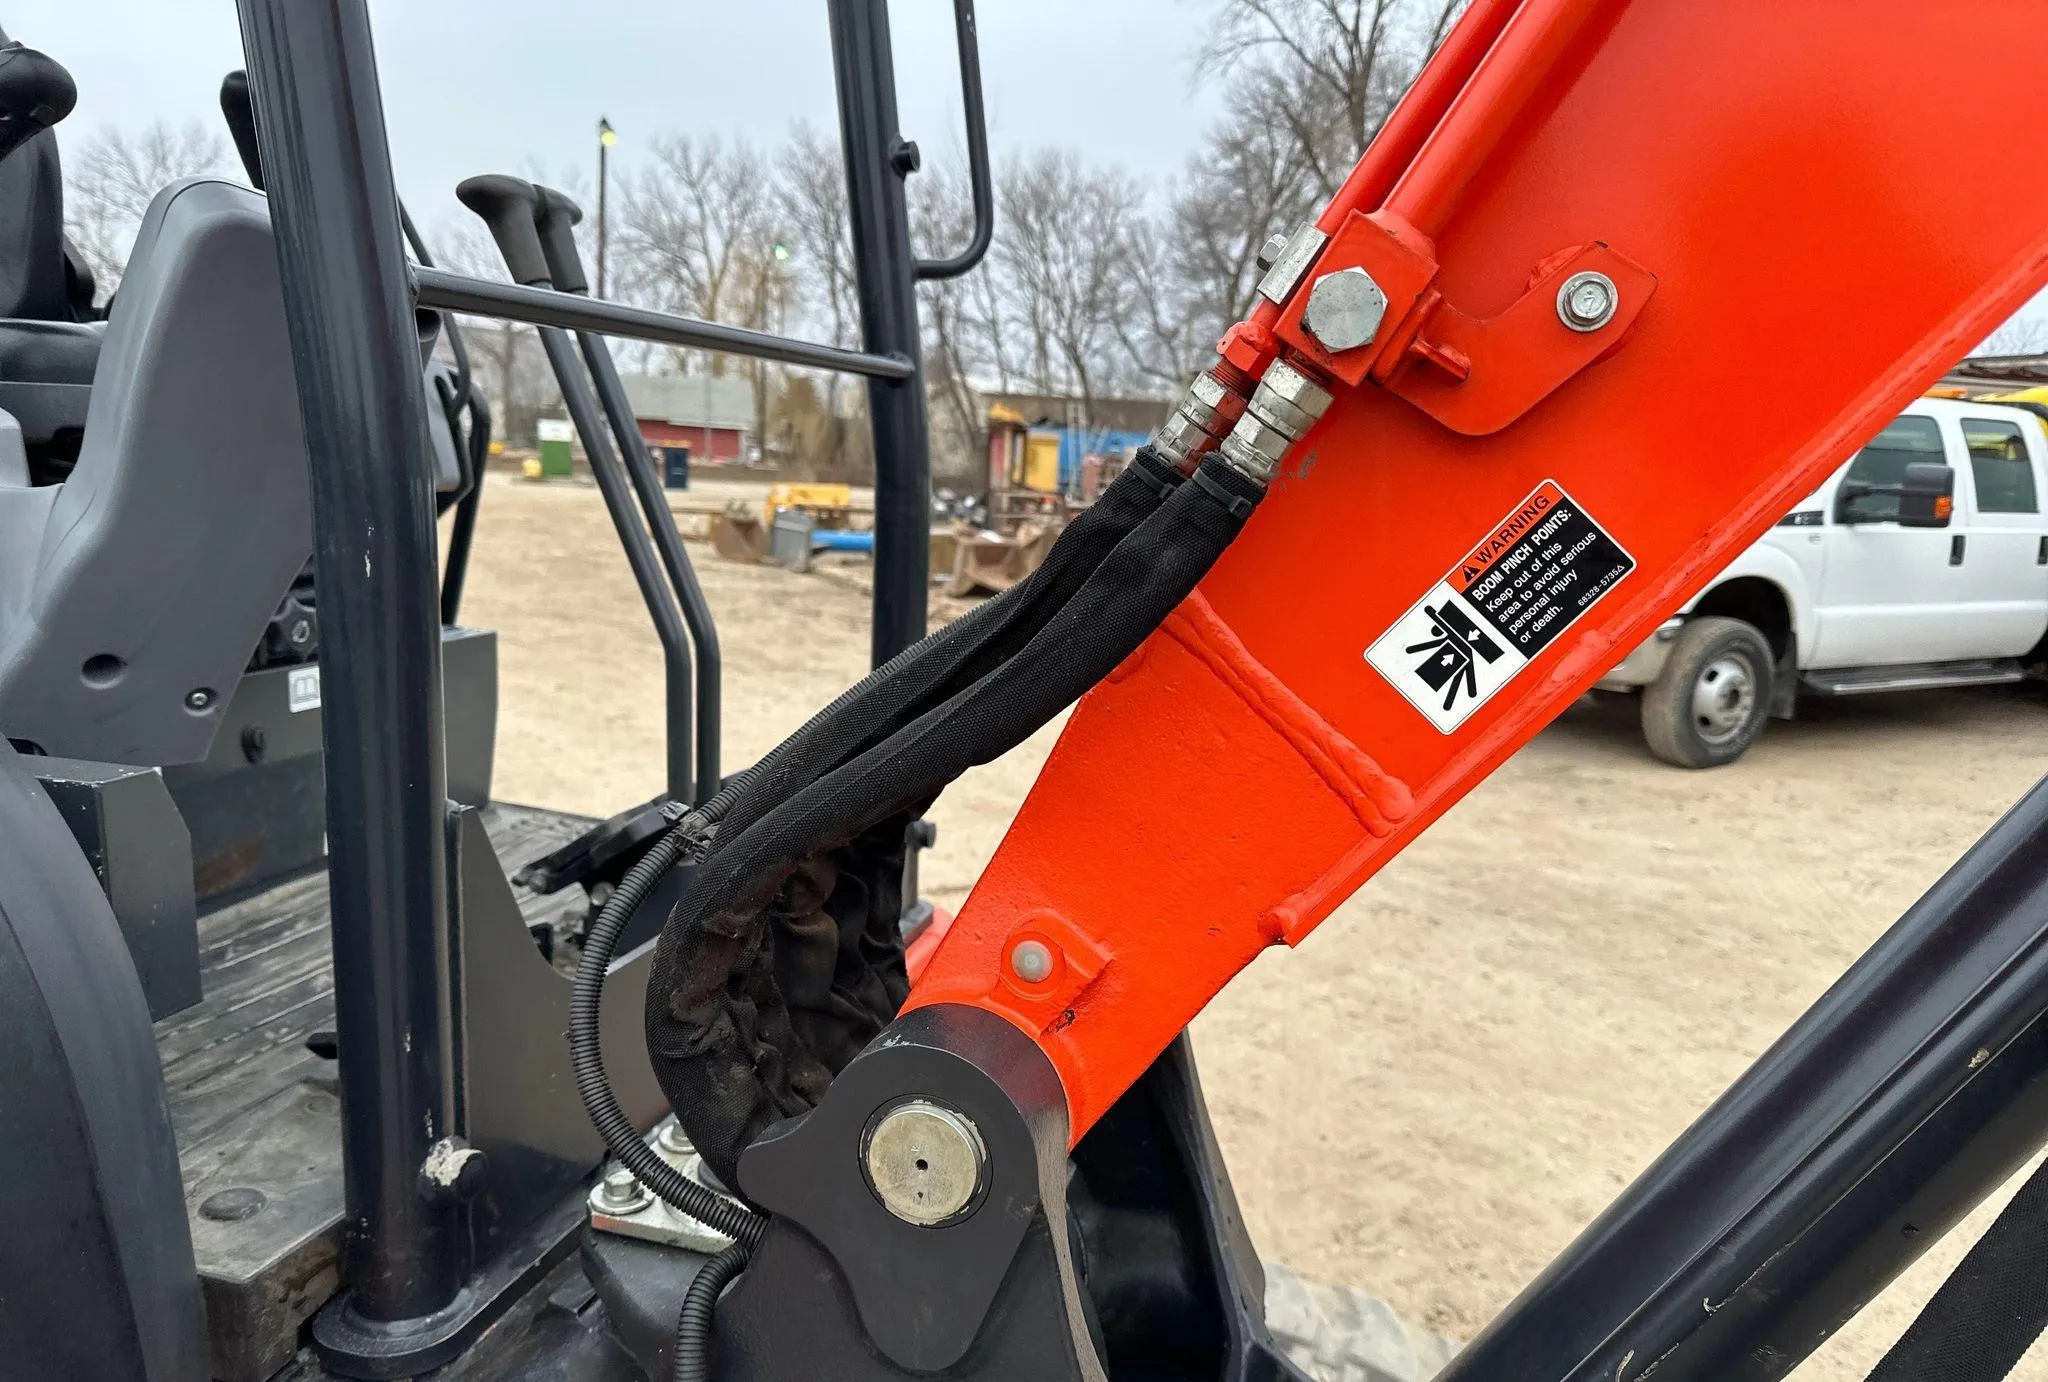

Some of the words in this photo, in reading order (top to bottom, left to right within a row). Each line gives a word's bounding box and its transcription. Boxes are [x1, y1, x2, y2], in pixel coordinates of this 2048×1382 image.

[1472, 570, 1504, 601] BOOM
[1502, 544, 1534, 574] PINCH
[1531, 509, 1572, 546] POINTS:
[1476, 495, 1550, 565] WARNING
[1486, 587, 1513, 612] Keep
[1514, 572, 1532, 588] out
[1531, 558, 1543, 572] of
[1542, 542, 1562, 560] this
[1498, 602, 1521, 622] area
[1520, 590, 1532, 602] to
[1534, 564, 1560, 591] avoid
[1560, 532, 1596, 566] serious
[1509, 593, 1550, 635] personal
[1548, 569, 1578, 596] injury
[1520, 632, 1534, 643] or
[1532, 606, 1563, 632] death.
